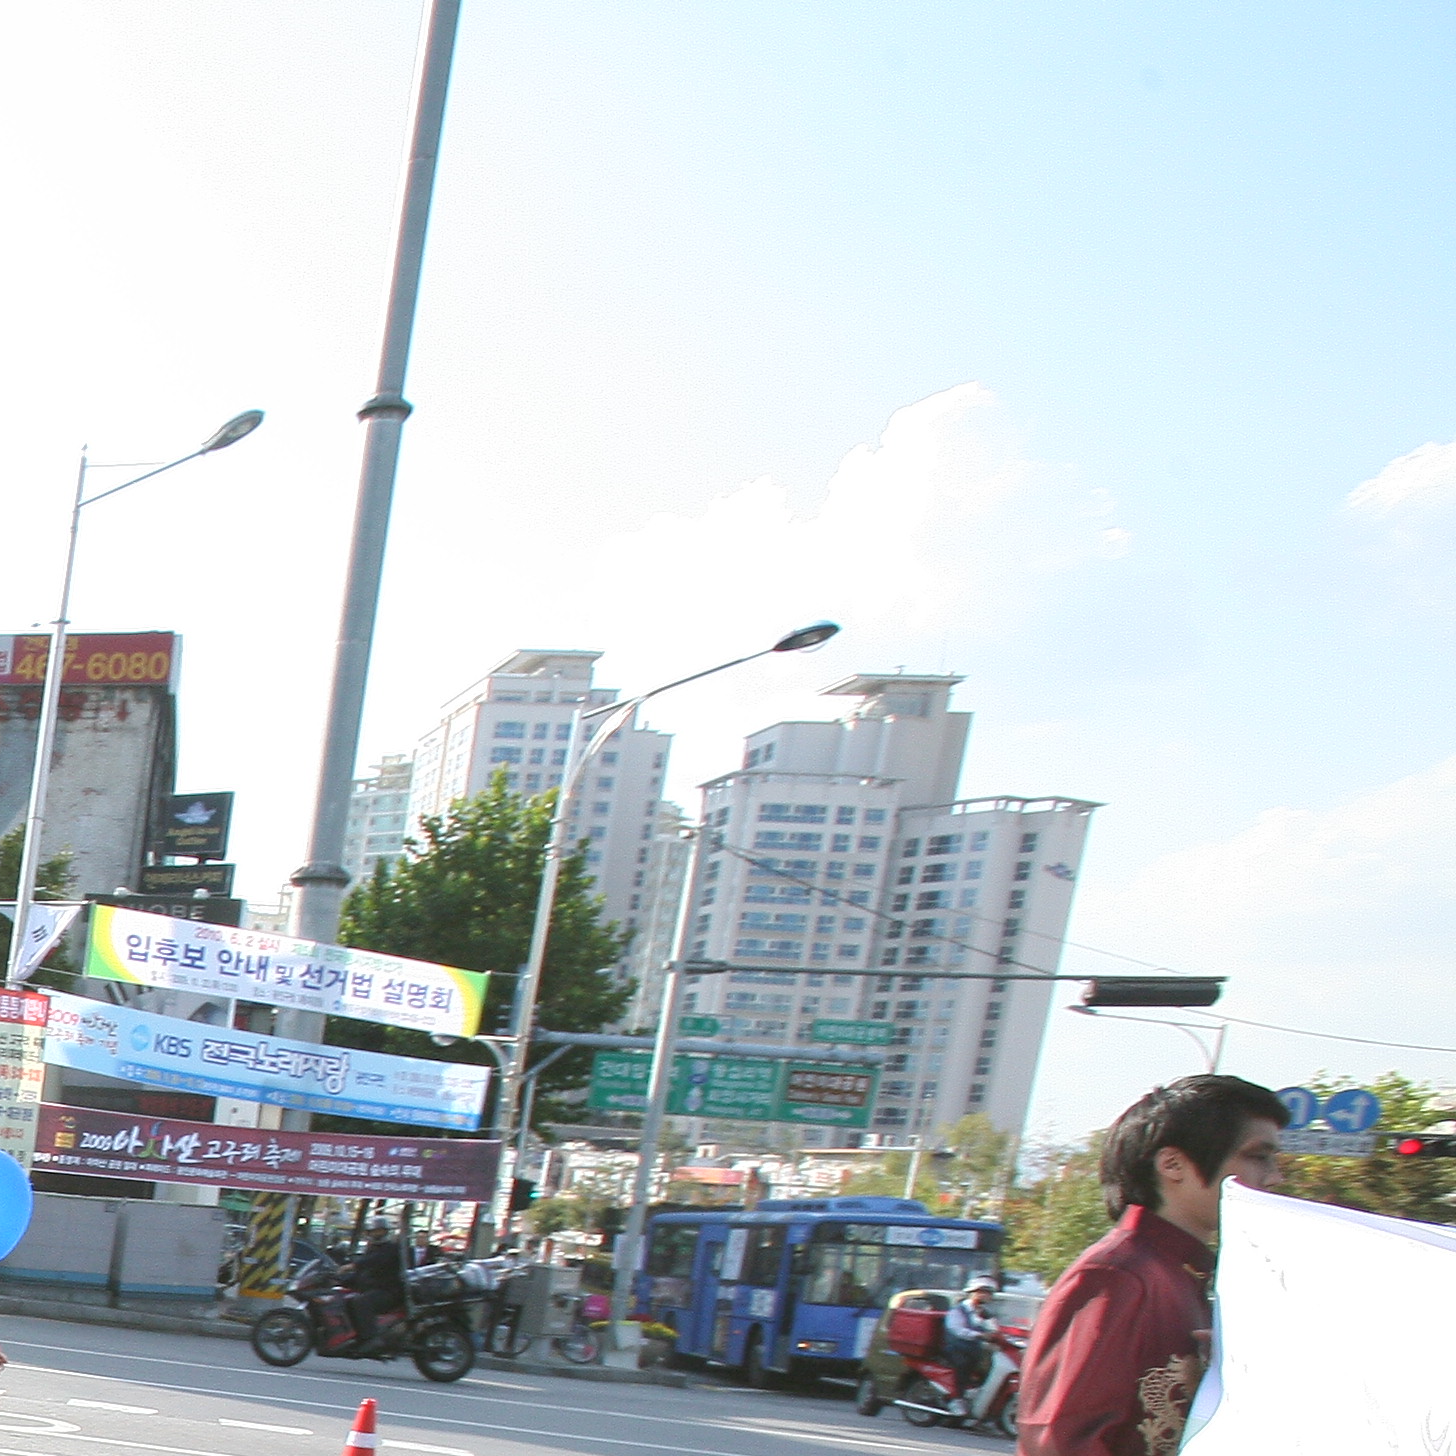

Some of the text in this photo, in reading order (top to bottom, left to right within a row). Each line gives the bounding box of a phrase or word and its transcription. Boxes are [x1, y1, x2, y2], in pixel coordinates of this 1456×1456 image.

[126, 933, 208, 971] 입후보
[217, 948, 271, 983] 안내
[274, 964, 295, 987] 및
[299, 962, 375, 1000] 선거법
[382, 977, 455, 1014] 설명회
[47, 1007, 81, 1026] 2009
[153, 1033, 193, 1059] KBS
[202, 1038, 350, 1095] 전국노래자랑
